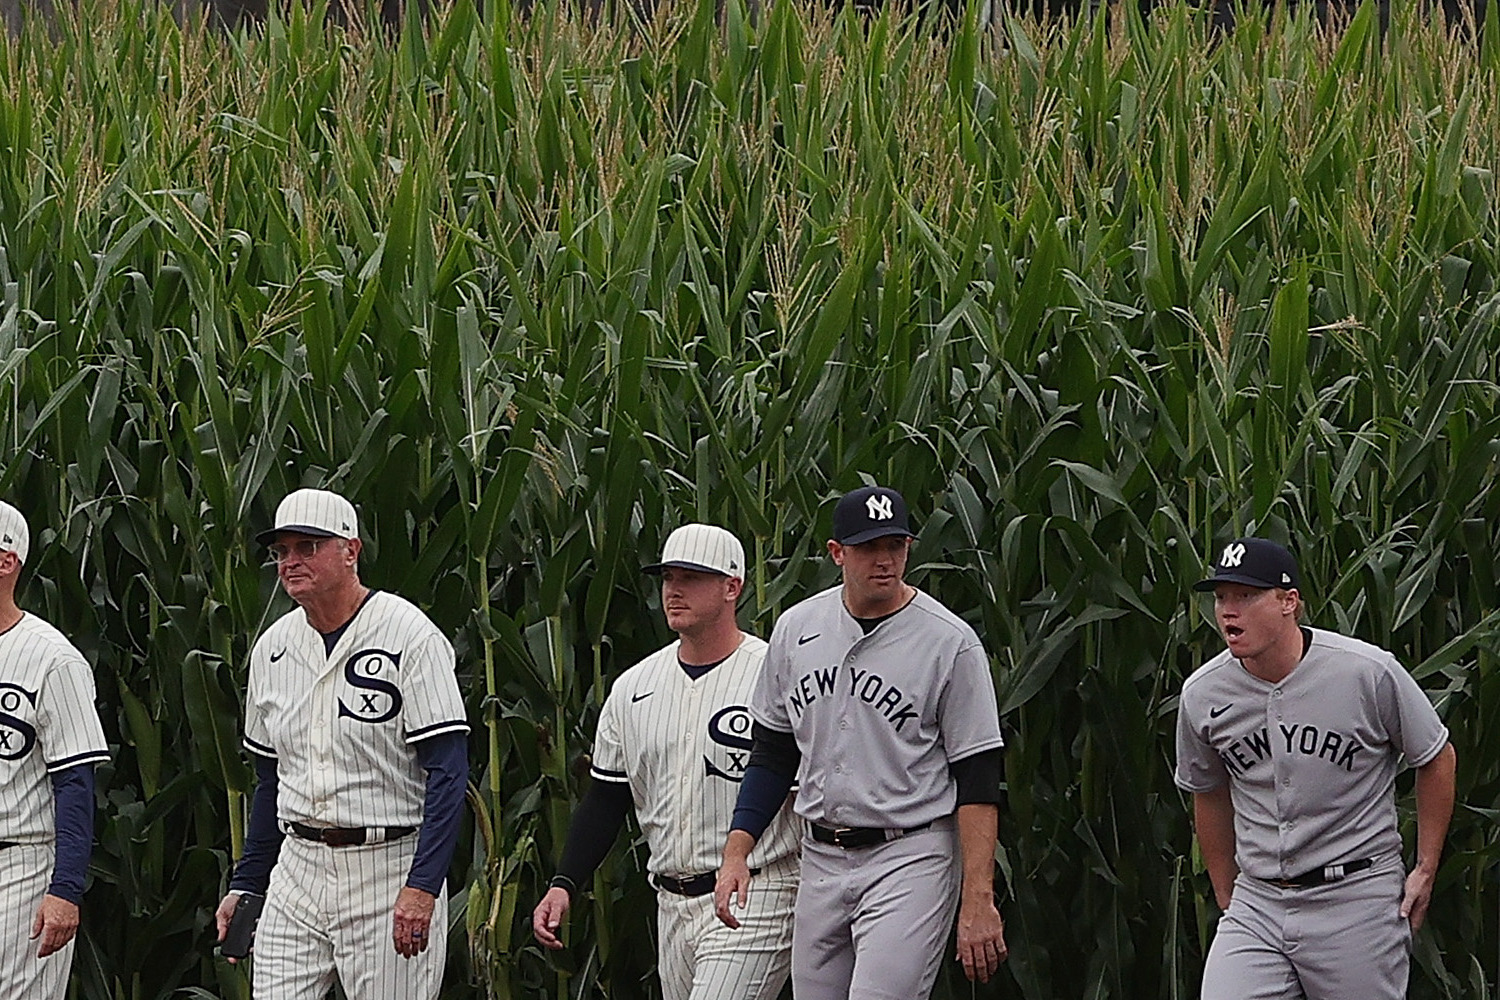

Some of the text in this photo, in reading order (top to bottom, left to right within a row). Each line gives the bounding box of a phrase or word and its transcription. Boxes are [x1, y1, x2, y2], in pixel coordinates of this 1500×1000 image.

[865, 494, 894, 520] NY
[1220, 543, 1246, 567] NY
[789, 666, 919, 733] NEW YORK
[1220, 724, 1365, 781] NEW YORK
